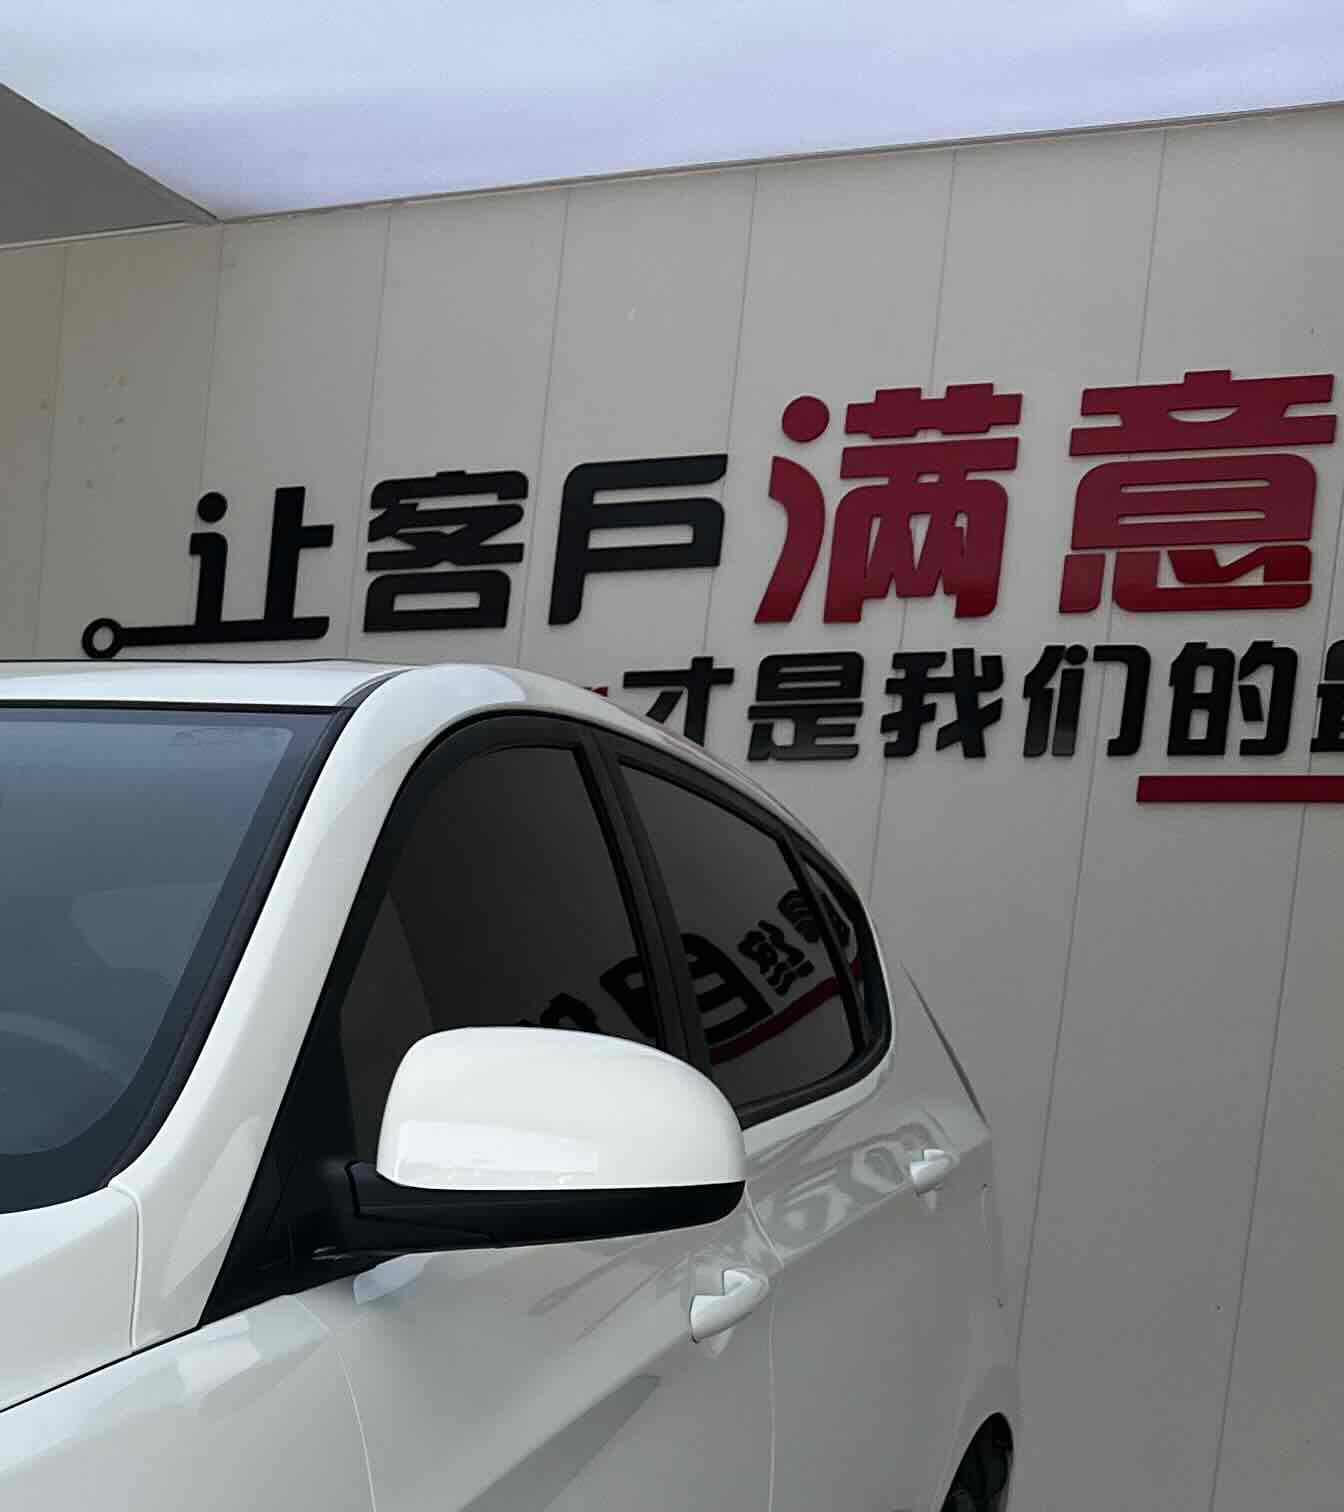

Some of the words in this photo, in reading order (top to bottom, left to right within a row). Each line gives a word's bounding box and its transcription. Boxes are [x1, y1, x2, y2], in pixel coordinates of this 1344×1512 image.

[82, 370, 1337, 660] 让客户满意
[622, 640, 1344, 762] 才是我们的
